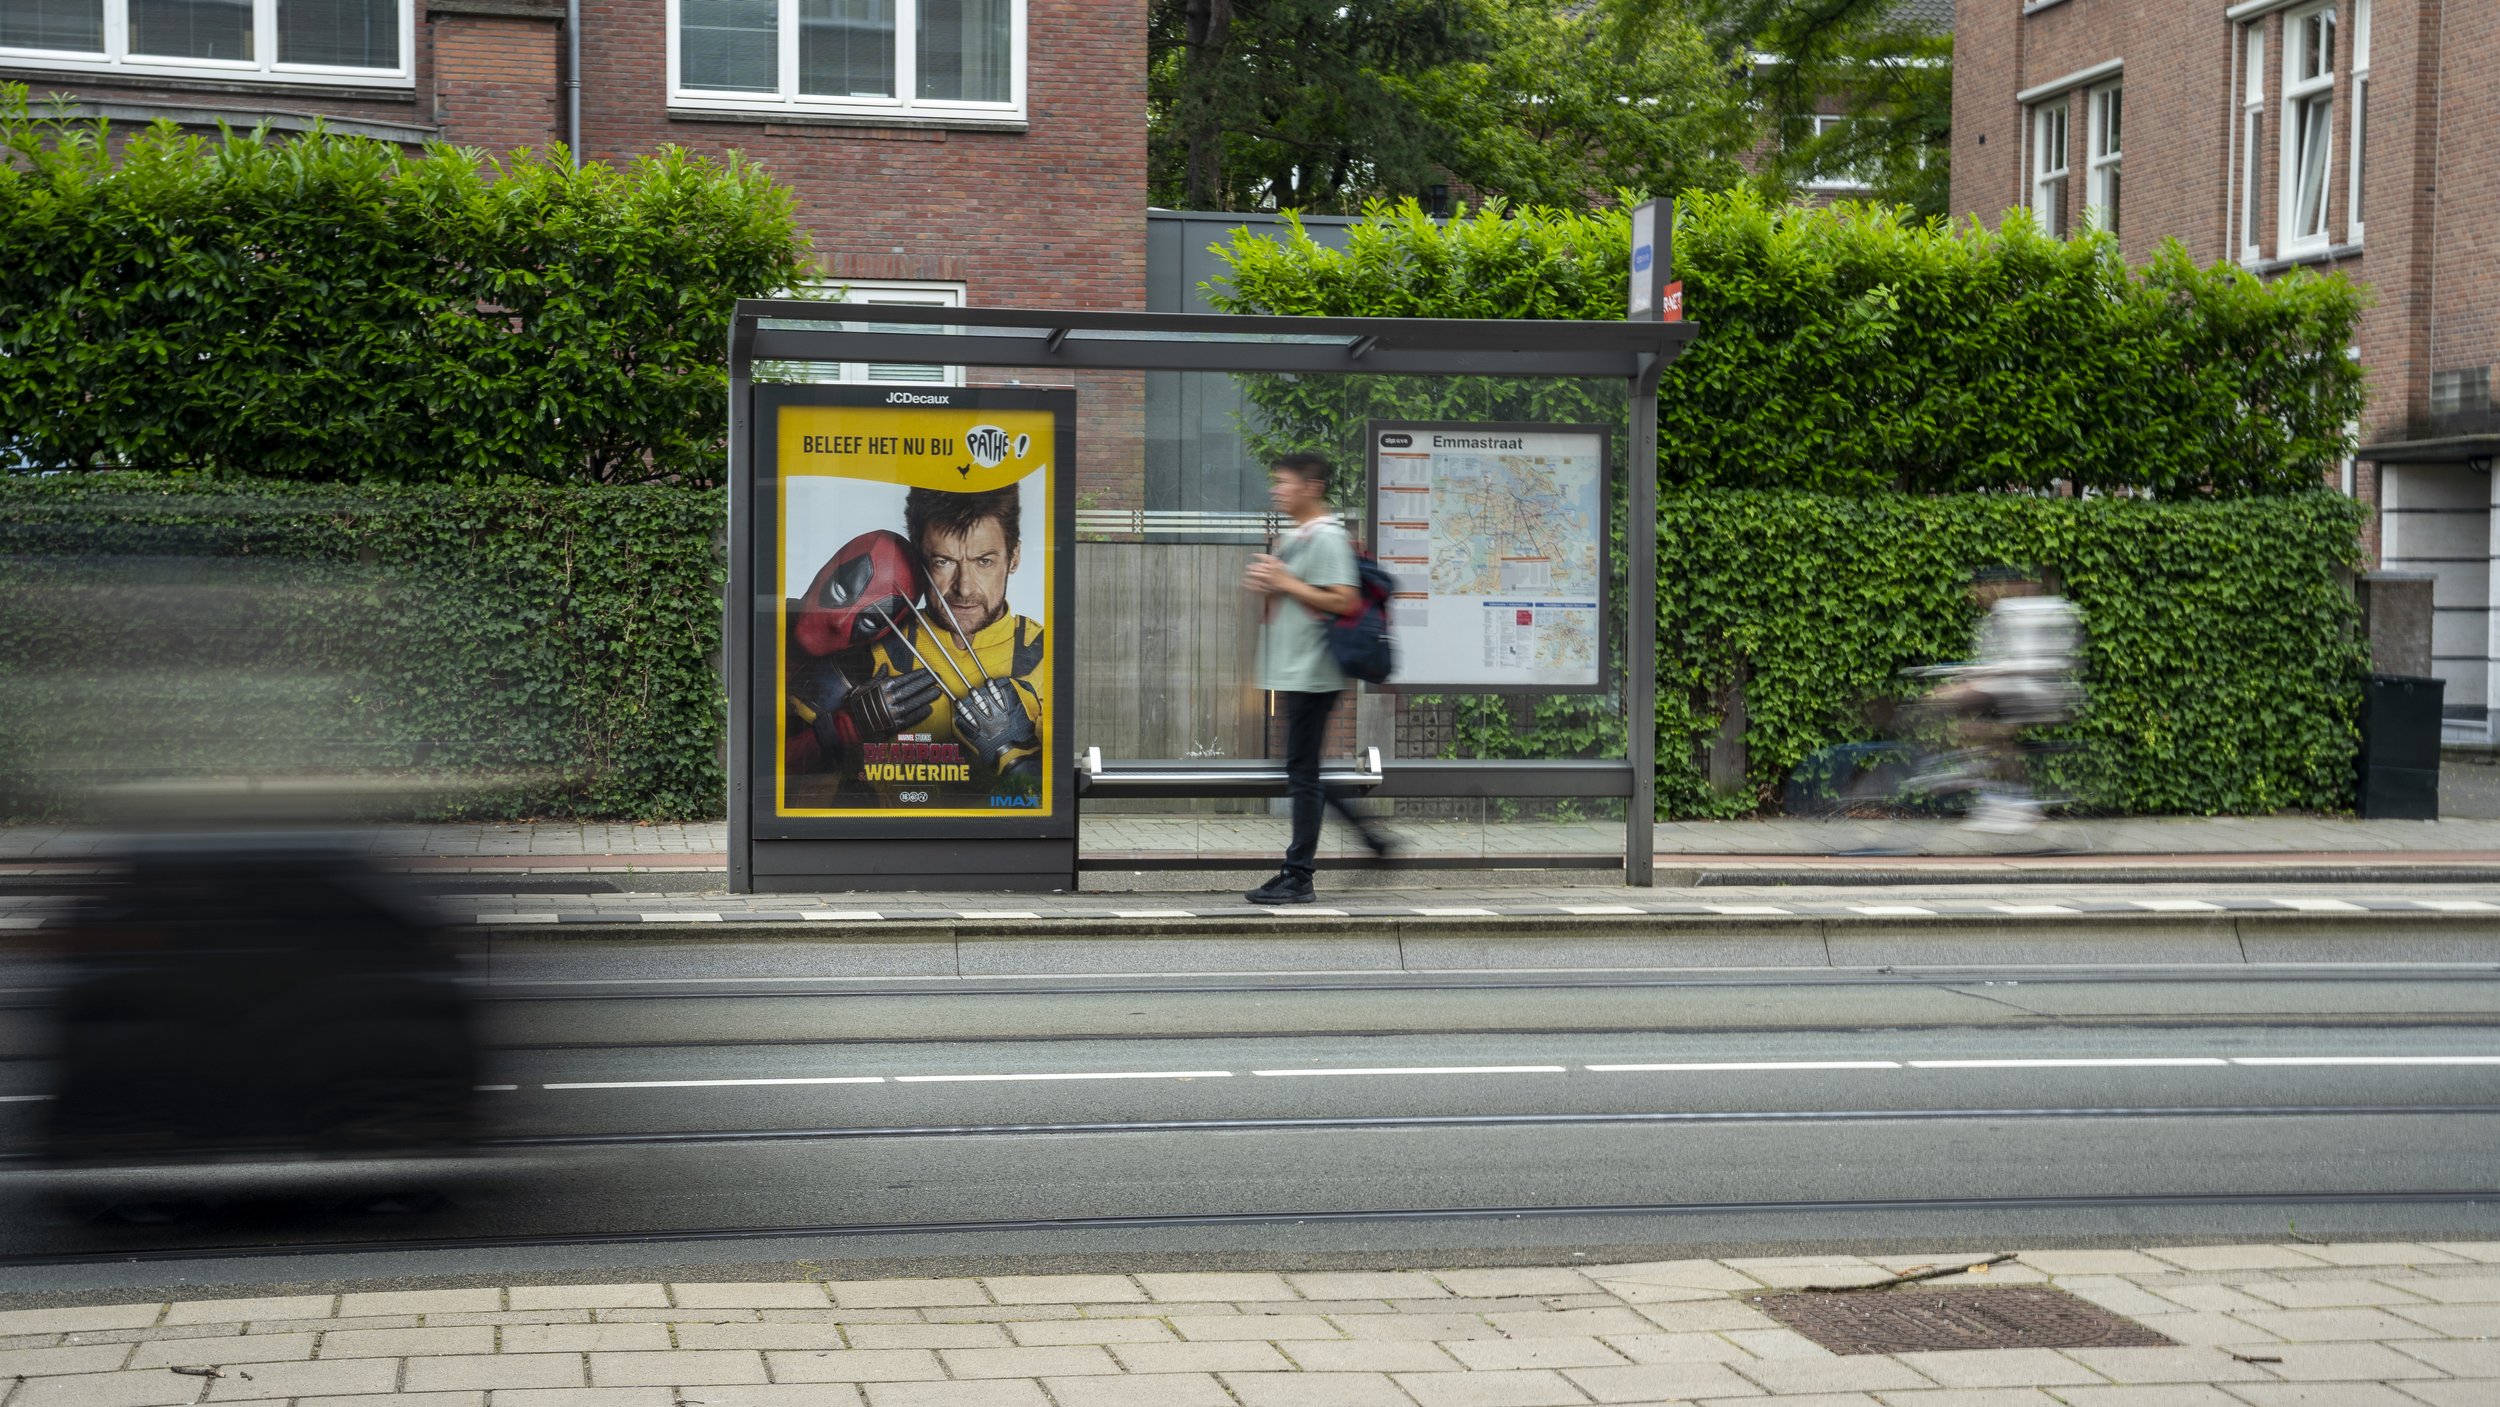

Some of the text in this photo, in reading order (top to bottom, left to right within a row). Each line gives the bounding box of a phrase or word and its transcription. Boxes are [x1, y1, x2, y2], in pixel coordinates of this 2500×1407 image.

[886, 392, 949, 405] JCDecaux
[803, 435, 863, 454] BELEEF
[868, 437, 898, 455] HET
[903, 438, 925, 455] NU
[930, 438, 953, 456] BIJ
[1433, 435, 1523, 450] Emmastraat
[897, 733, 932, 742] MARVEL STUDIOS
[863, 743, 966, 764] DEADPOOL
[865, 764, 970, 782] WOLVERINE
[990, 796, 1039, 807] IMAX
